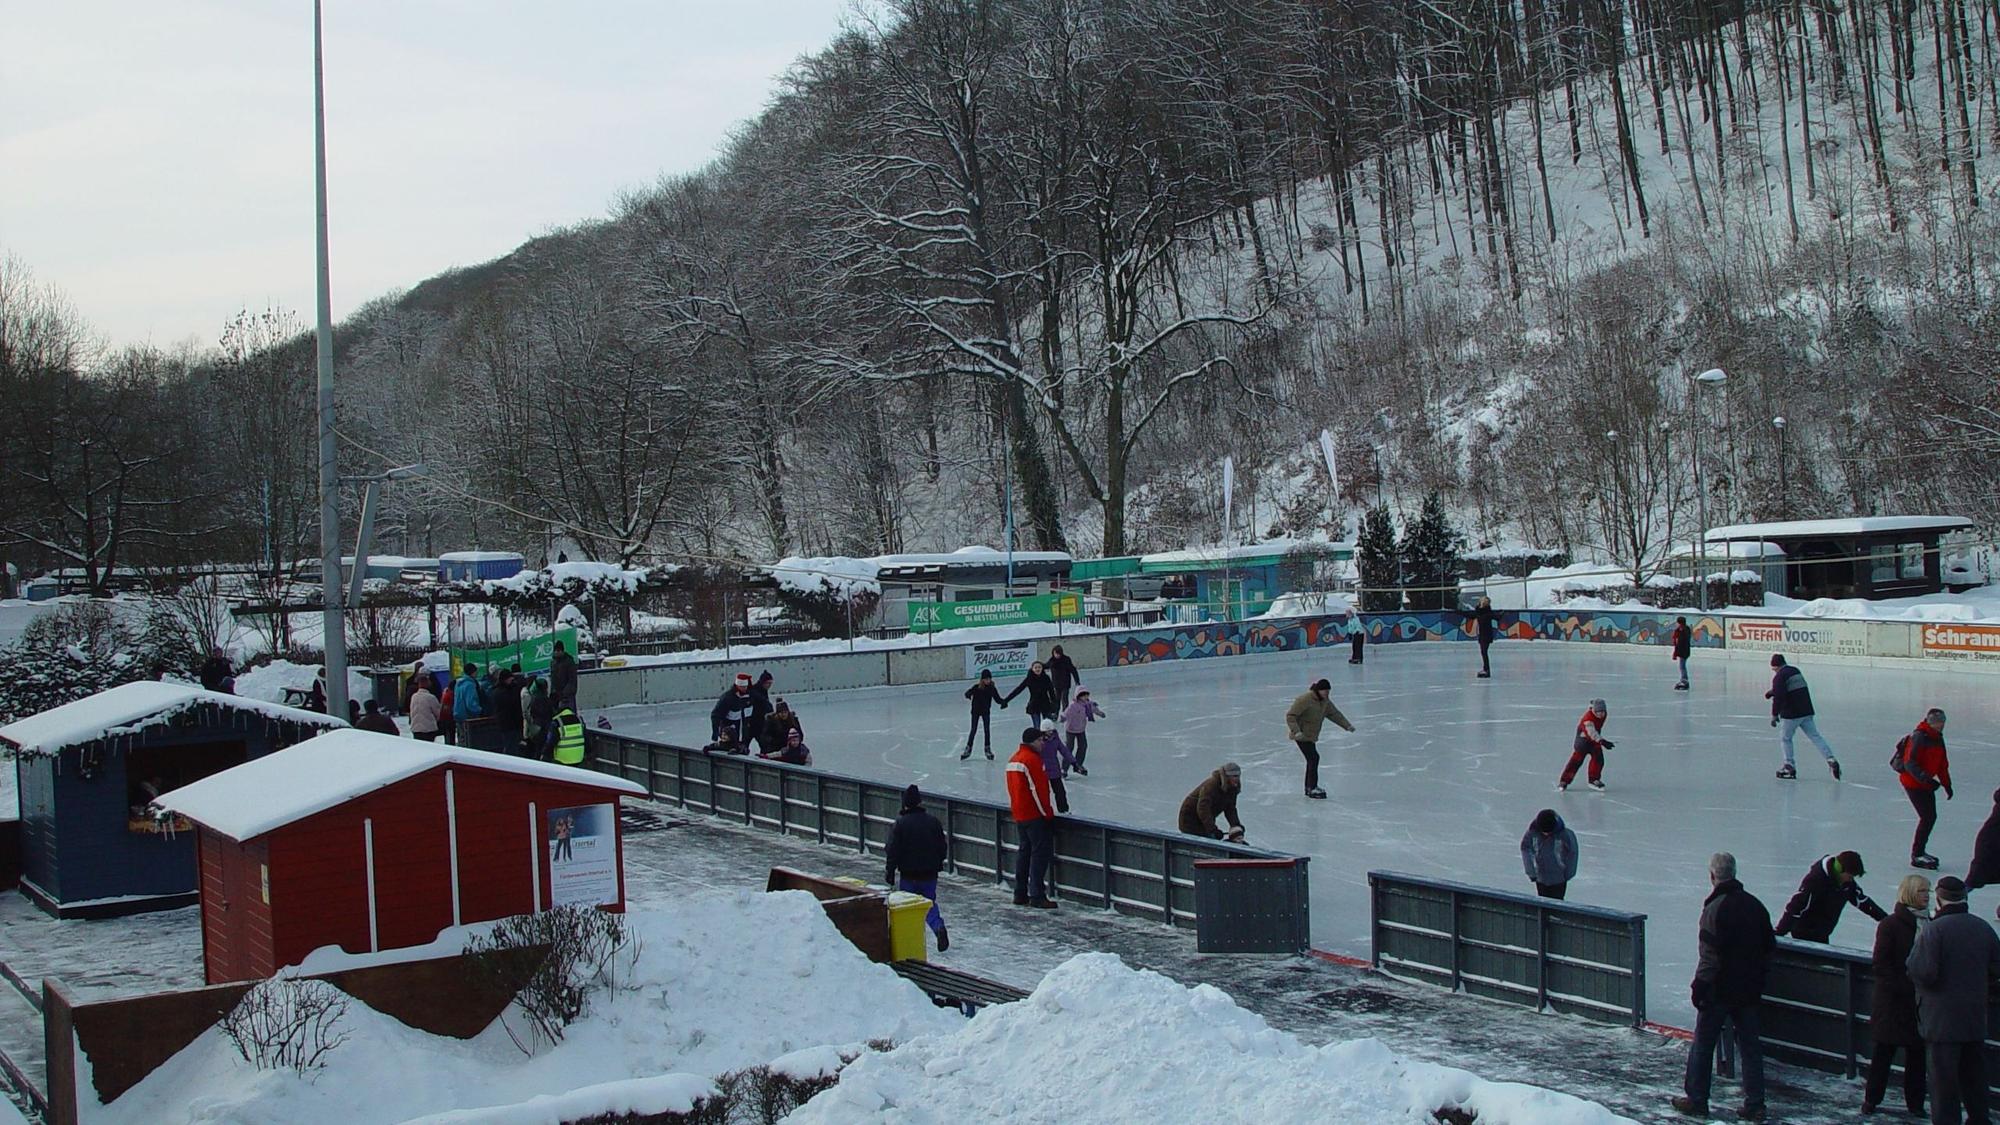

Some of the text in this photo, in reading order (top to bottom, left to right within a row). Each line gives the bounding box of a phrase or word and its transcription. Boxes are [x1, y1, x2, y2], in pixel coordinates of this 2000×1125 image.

[913, 606, 940, 621] AOK
[954, 602, 1023, 615] GESUNDHEIT
[974, 613, 998, 622] BESTEN
[1731, 623, 1818, 643] STEFAN VOOS
[1925, 628, 2000, 646] Schram
[974, 650, 1028, 665] RADIO RSG
